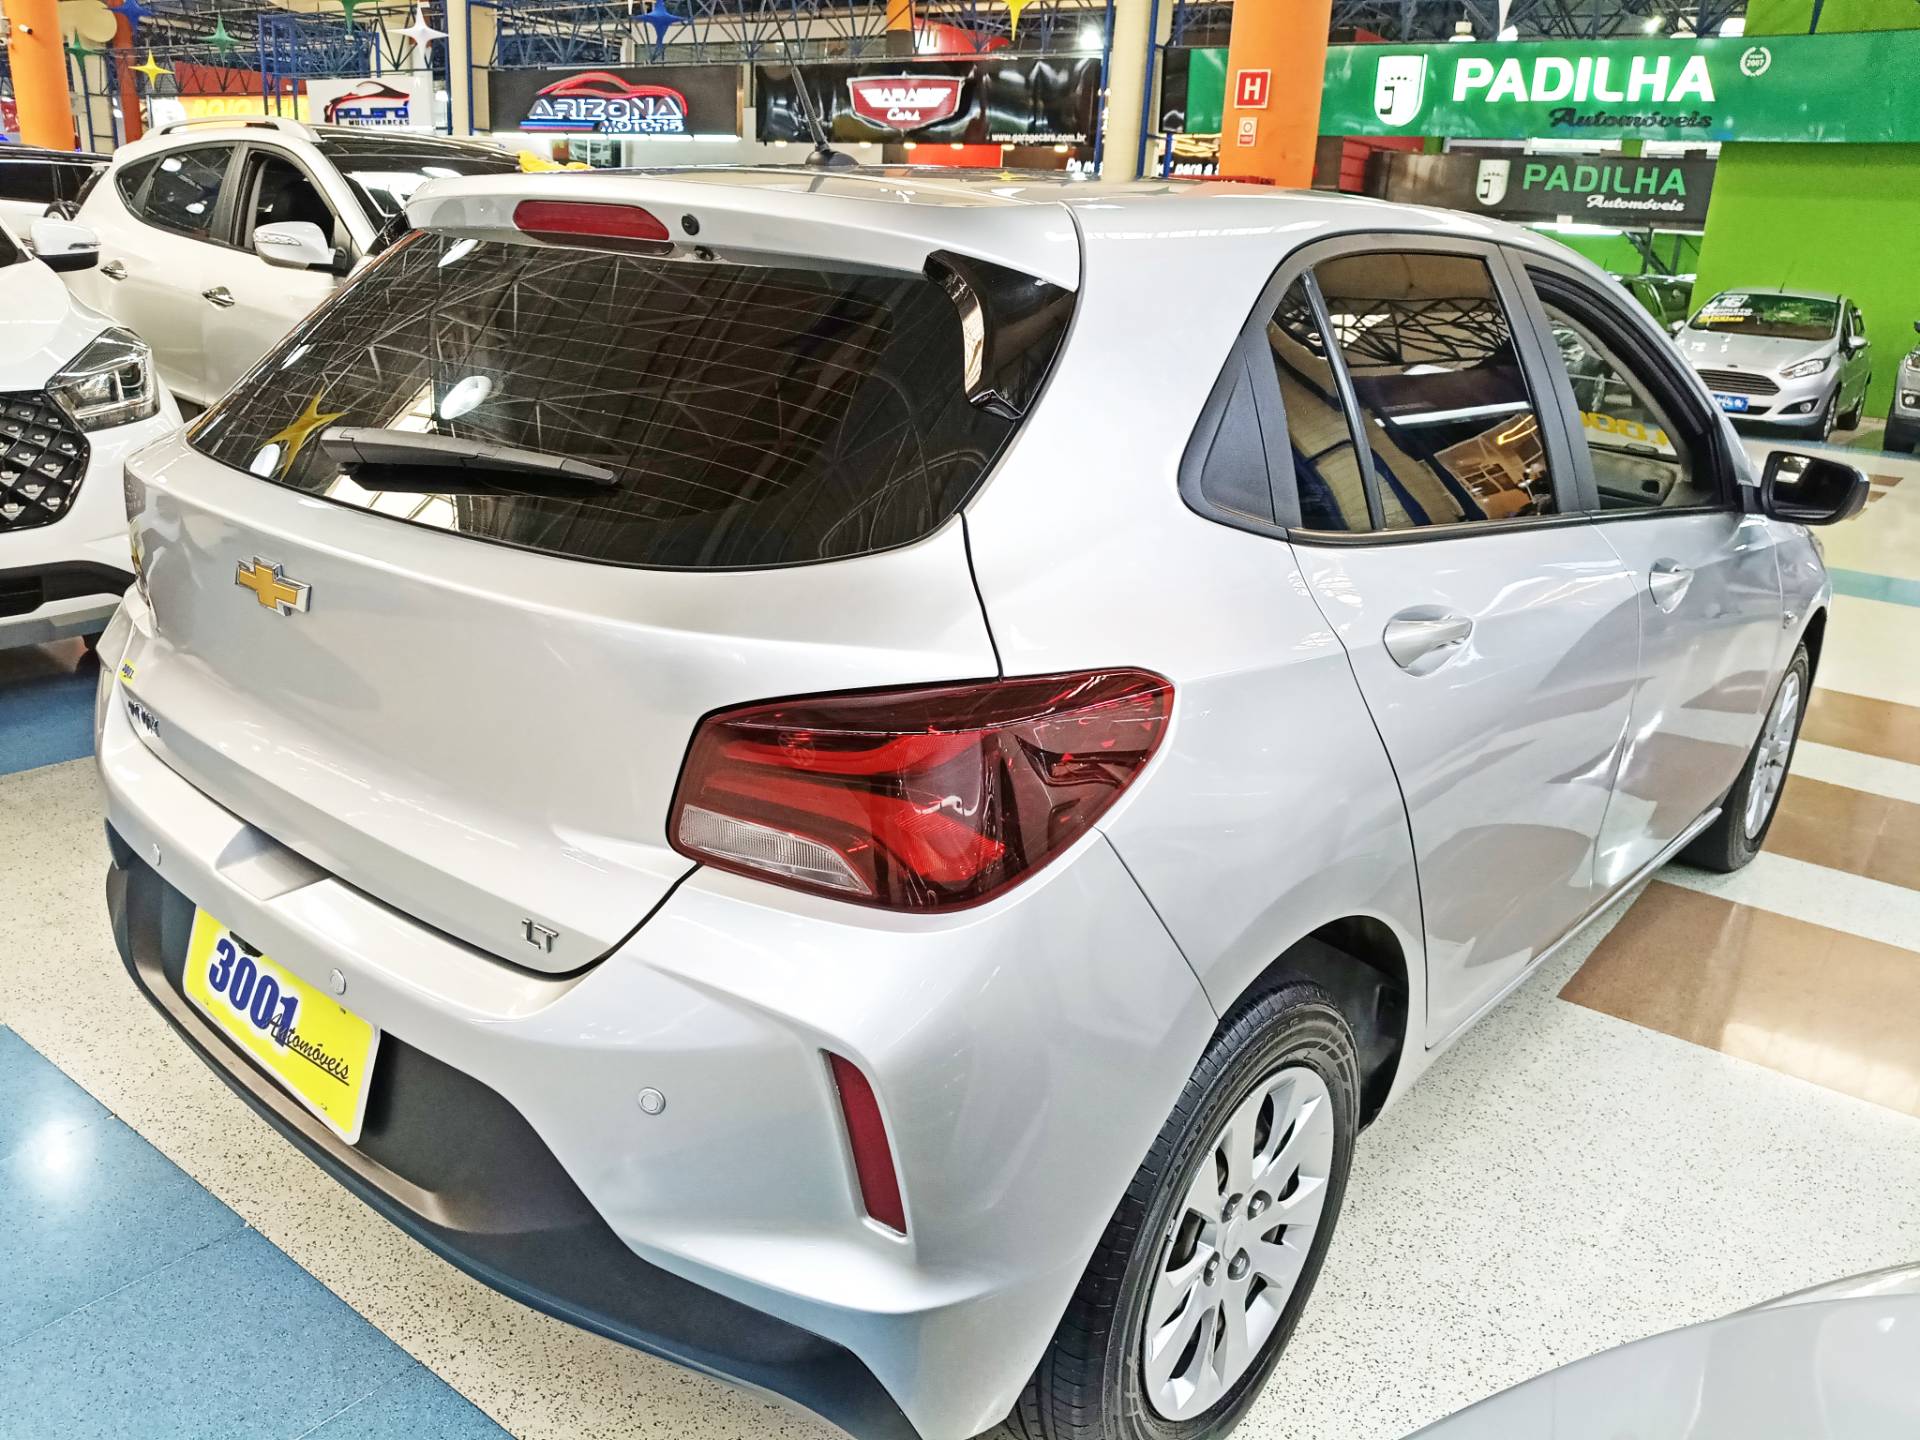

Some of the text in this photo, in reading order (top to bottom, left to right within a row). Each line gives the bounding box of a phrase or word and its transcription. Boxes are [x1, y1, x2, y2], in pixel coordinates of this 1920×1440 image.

[1243, 77, 1262, 101] H
[1452, 55, 1716, 103] PADILHA
[527, 96, 686, 121] ARIZONA
[600, 119, 686, 133] MOTORS
[1522, 163, 1687, 196] PADILHA
[1586, 195, 1686, 212] Automóveis
[521, 917, 560, 954] LT
[208, 937, 300, 1047] 3001
[265, 1010, 350, 1081] Automóveis
